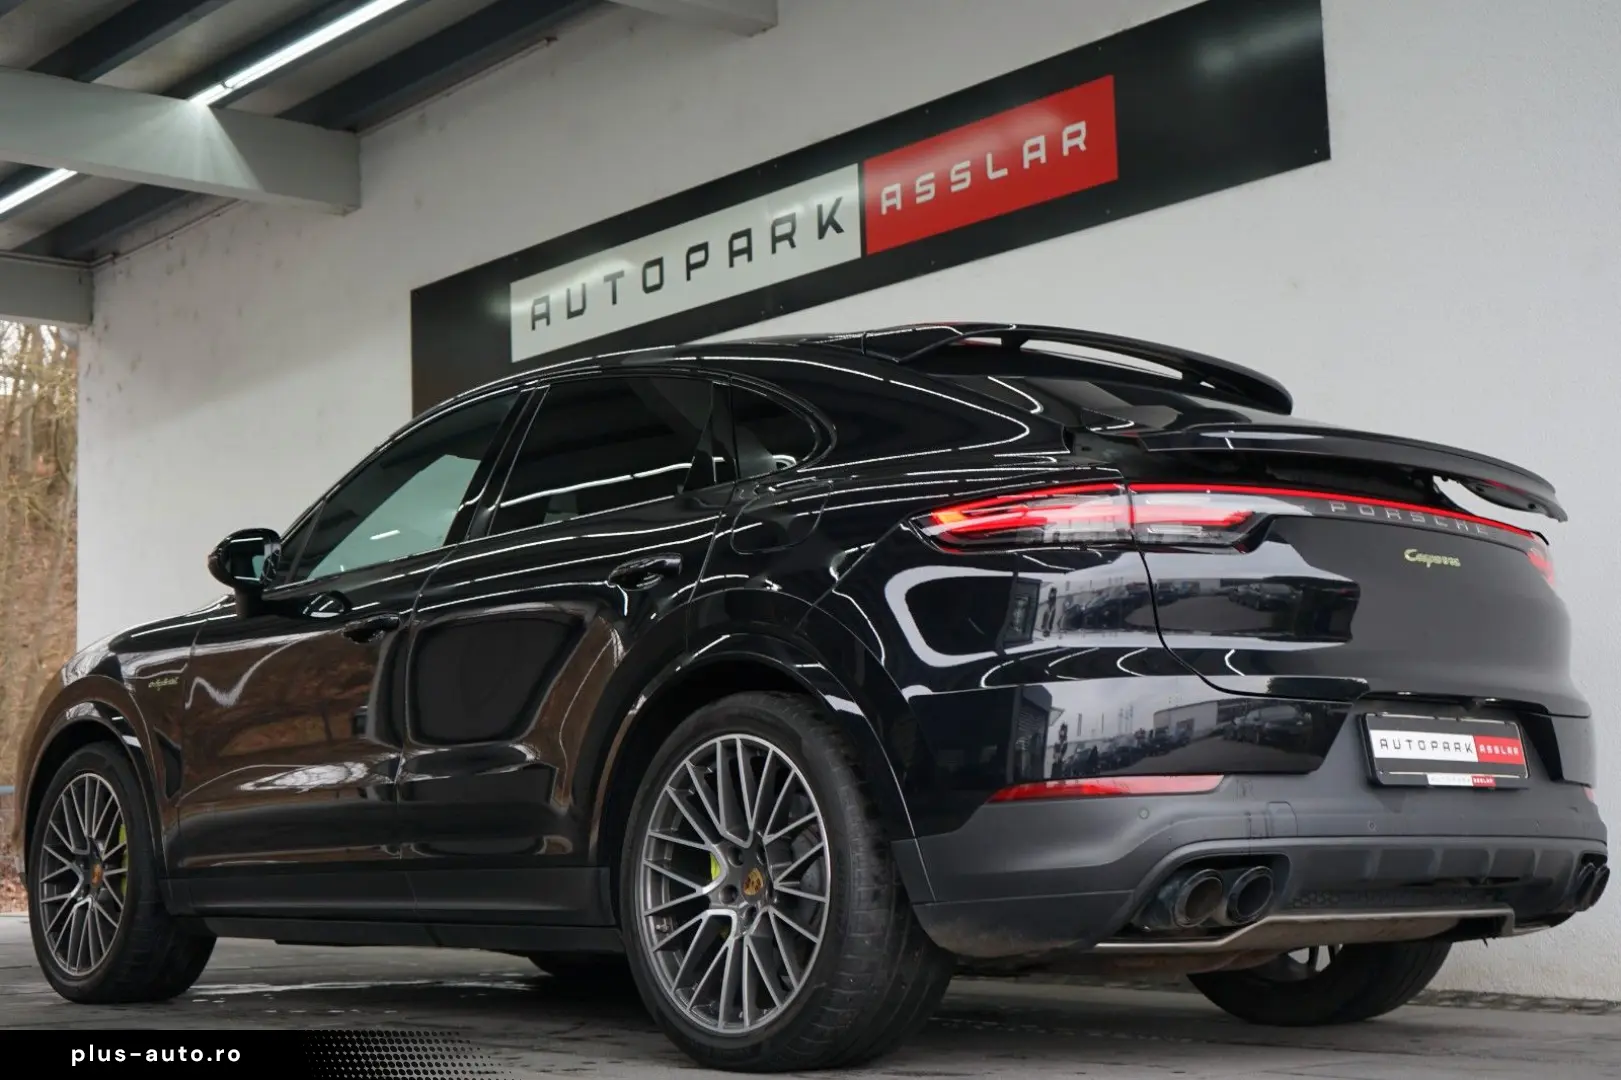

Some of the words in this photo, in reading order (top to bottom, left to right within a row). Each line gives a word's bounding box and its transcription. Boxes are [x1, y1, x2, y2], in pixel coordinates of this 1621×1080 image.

[530, 196, 845, 331] AUTOPARK
[880, 120, 1088, 216] ASSLAR
[1330, 500, 1489, 535] PORSCHE
[1379, 738, 1473, 753] AUTOPARK
